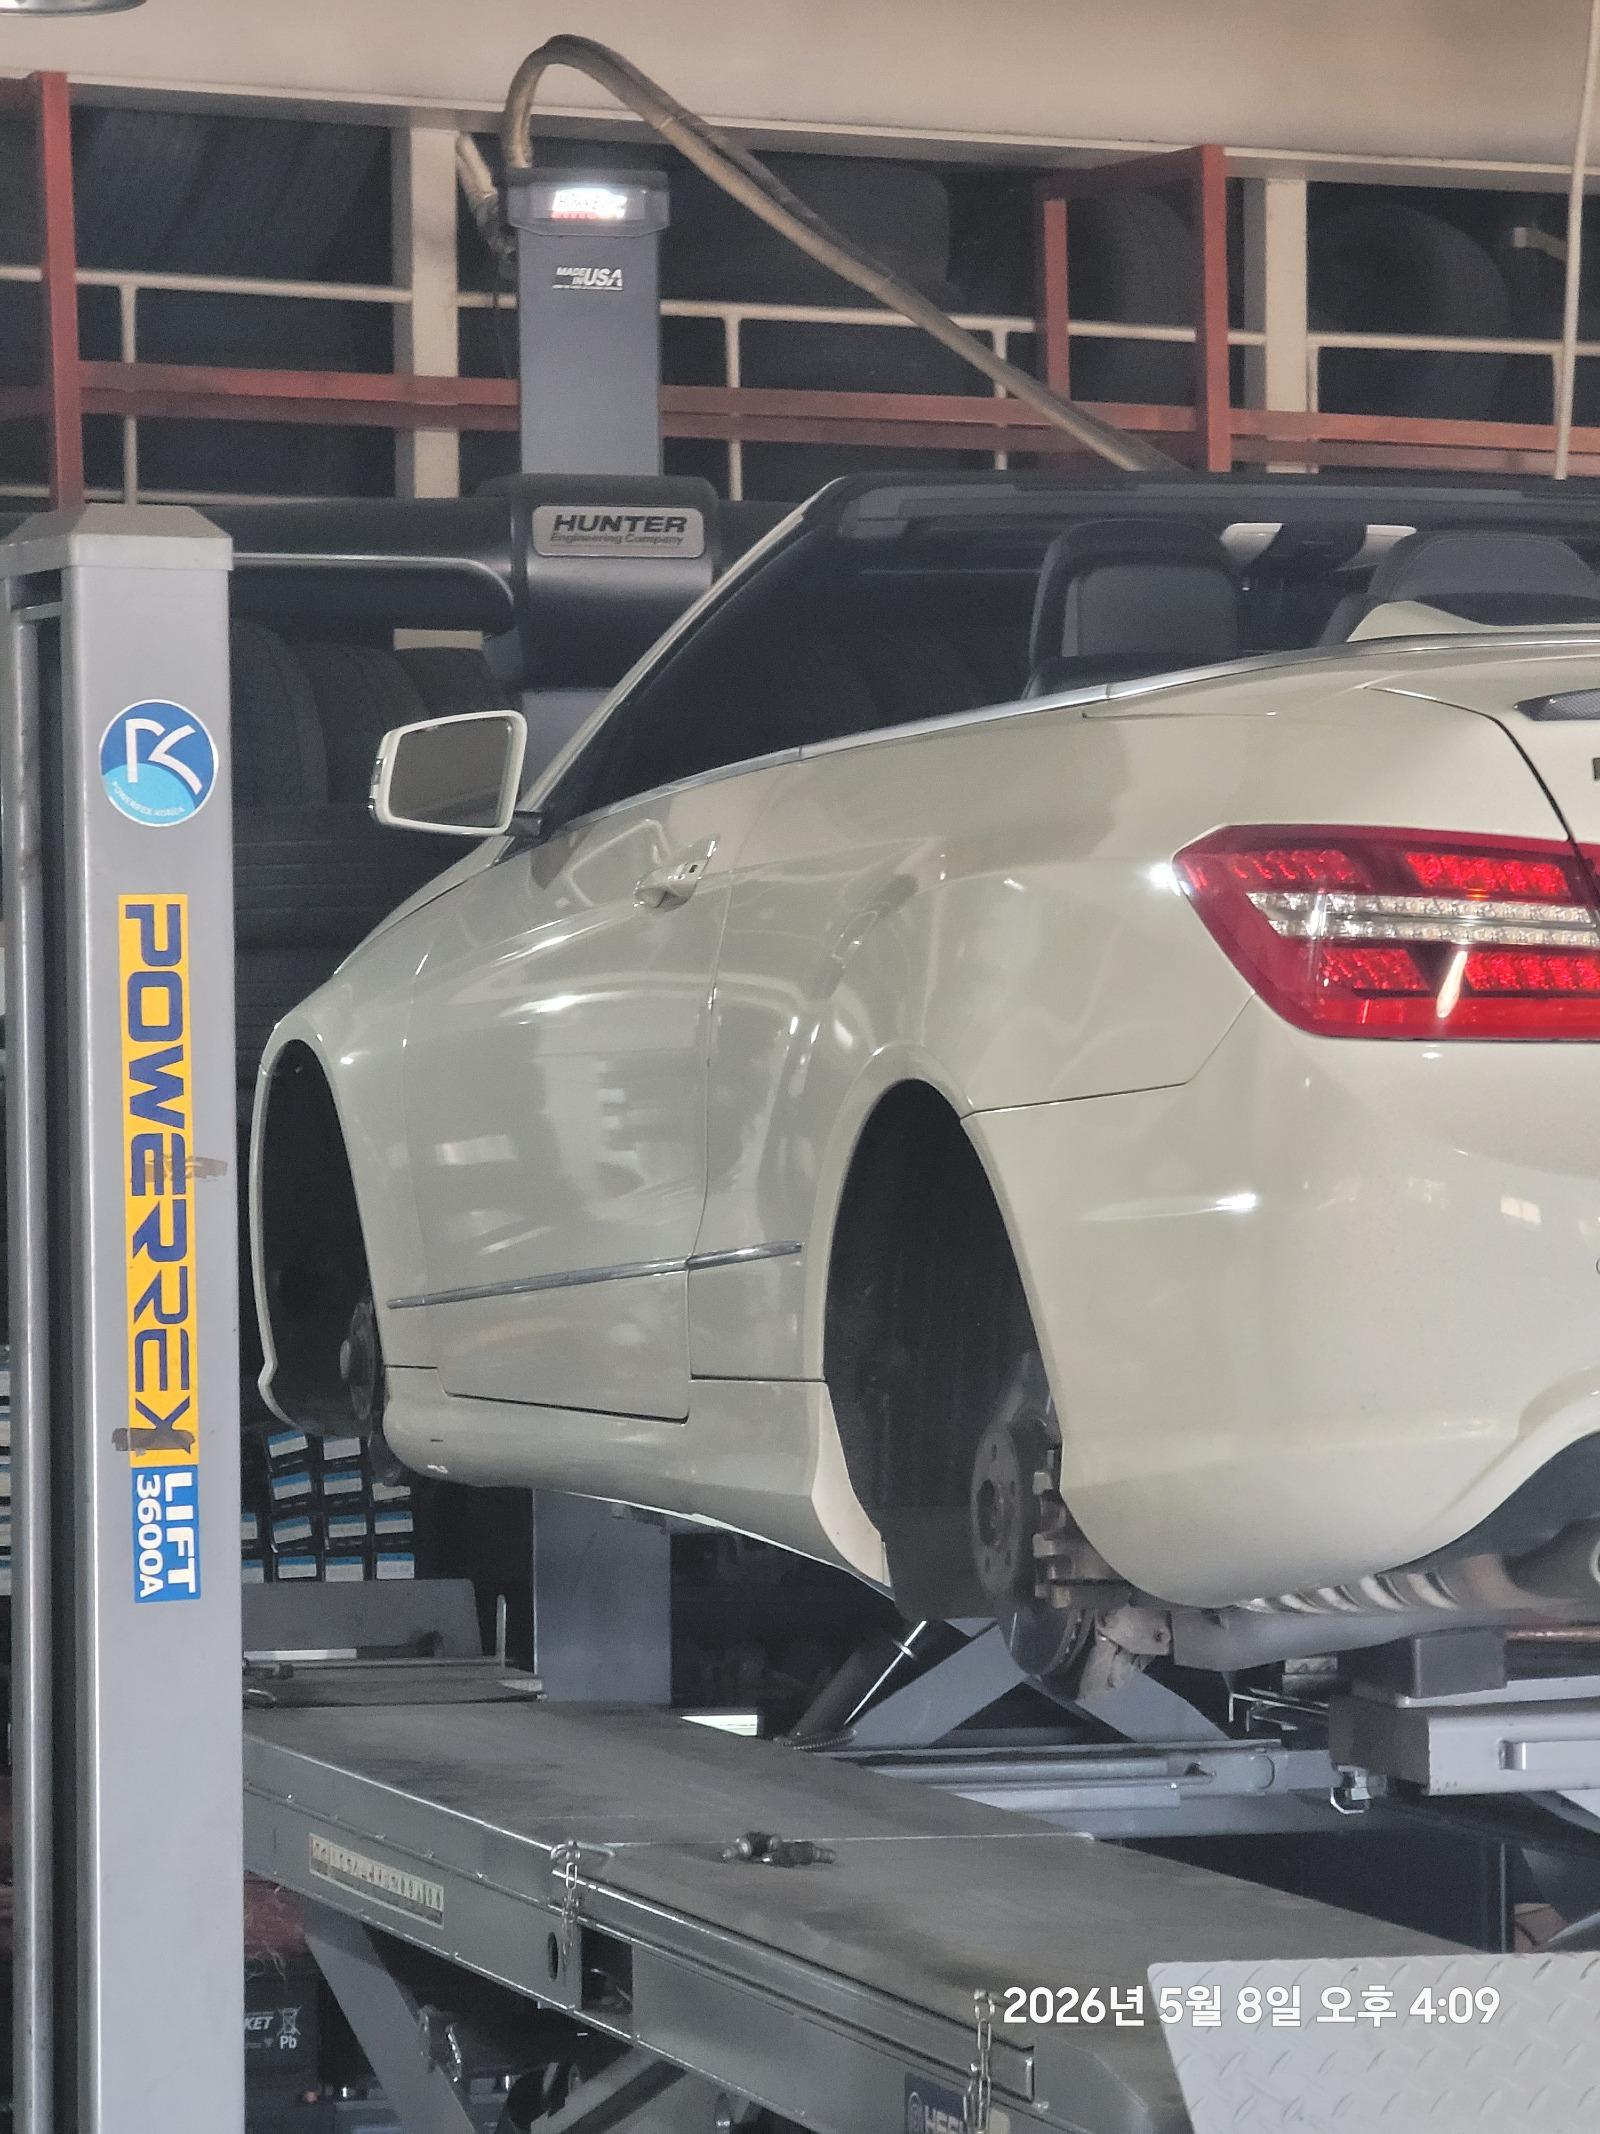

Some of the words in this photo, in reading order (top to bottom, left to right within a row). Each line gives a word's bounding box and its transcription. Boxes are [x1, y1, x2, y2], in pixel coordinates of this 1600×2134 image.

[556, 267, 586, 277] MADE
[584, 268, 623, 287] USA
[554, 514, 688, 533] HUNTER
[551, 532, 622, 545] Engineering
[625, 533, 684, 545] Company
[136, 1474, 164, 1599] 3600A
[165, 1471, 196, 1594] LIFT
[280, 2035, 297, 2049] Pb
